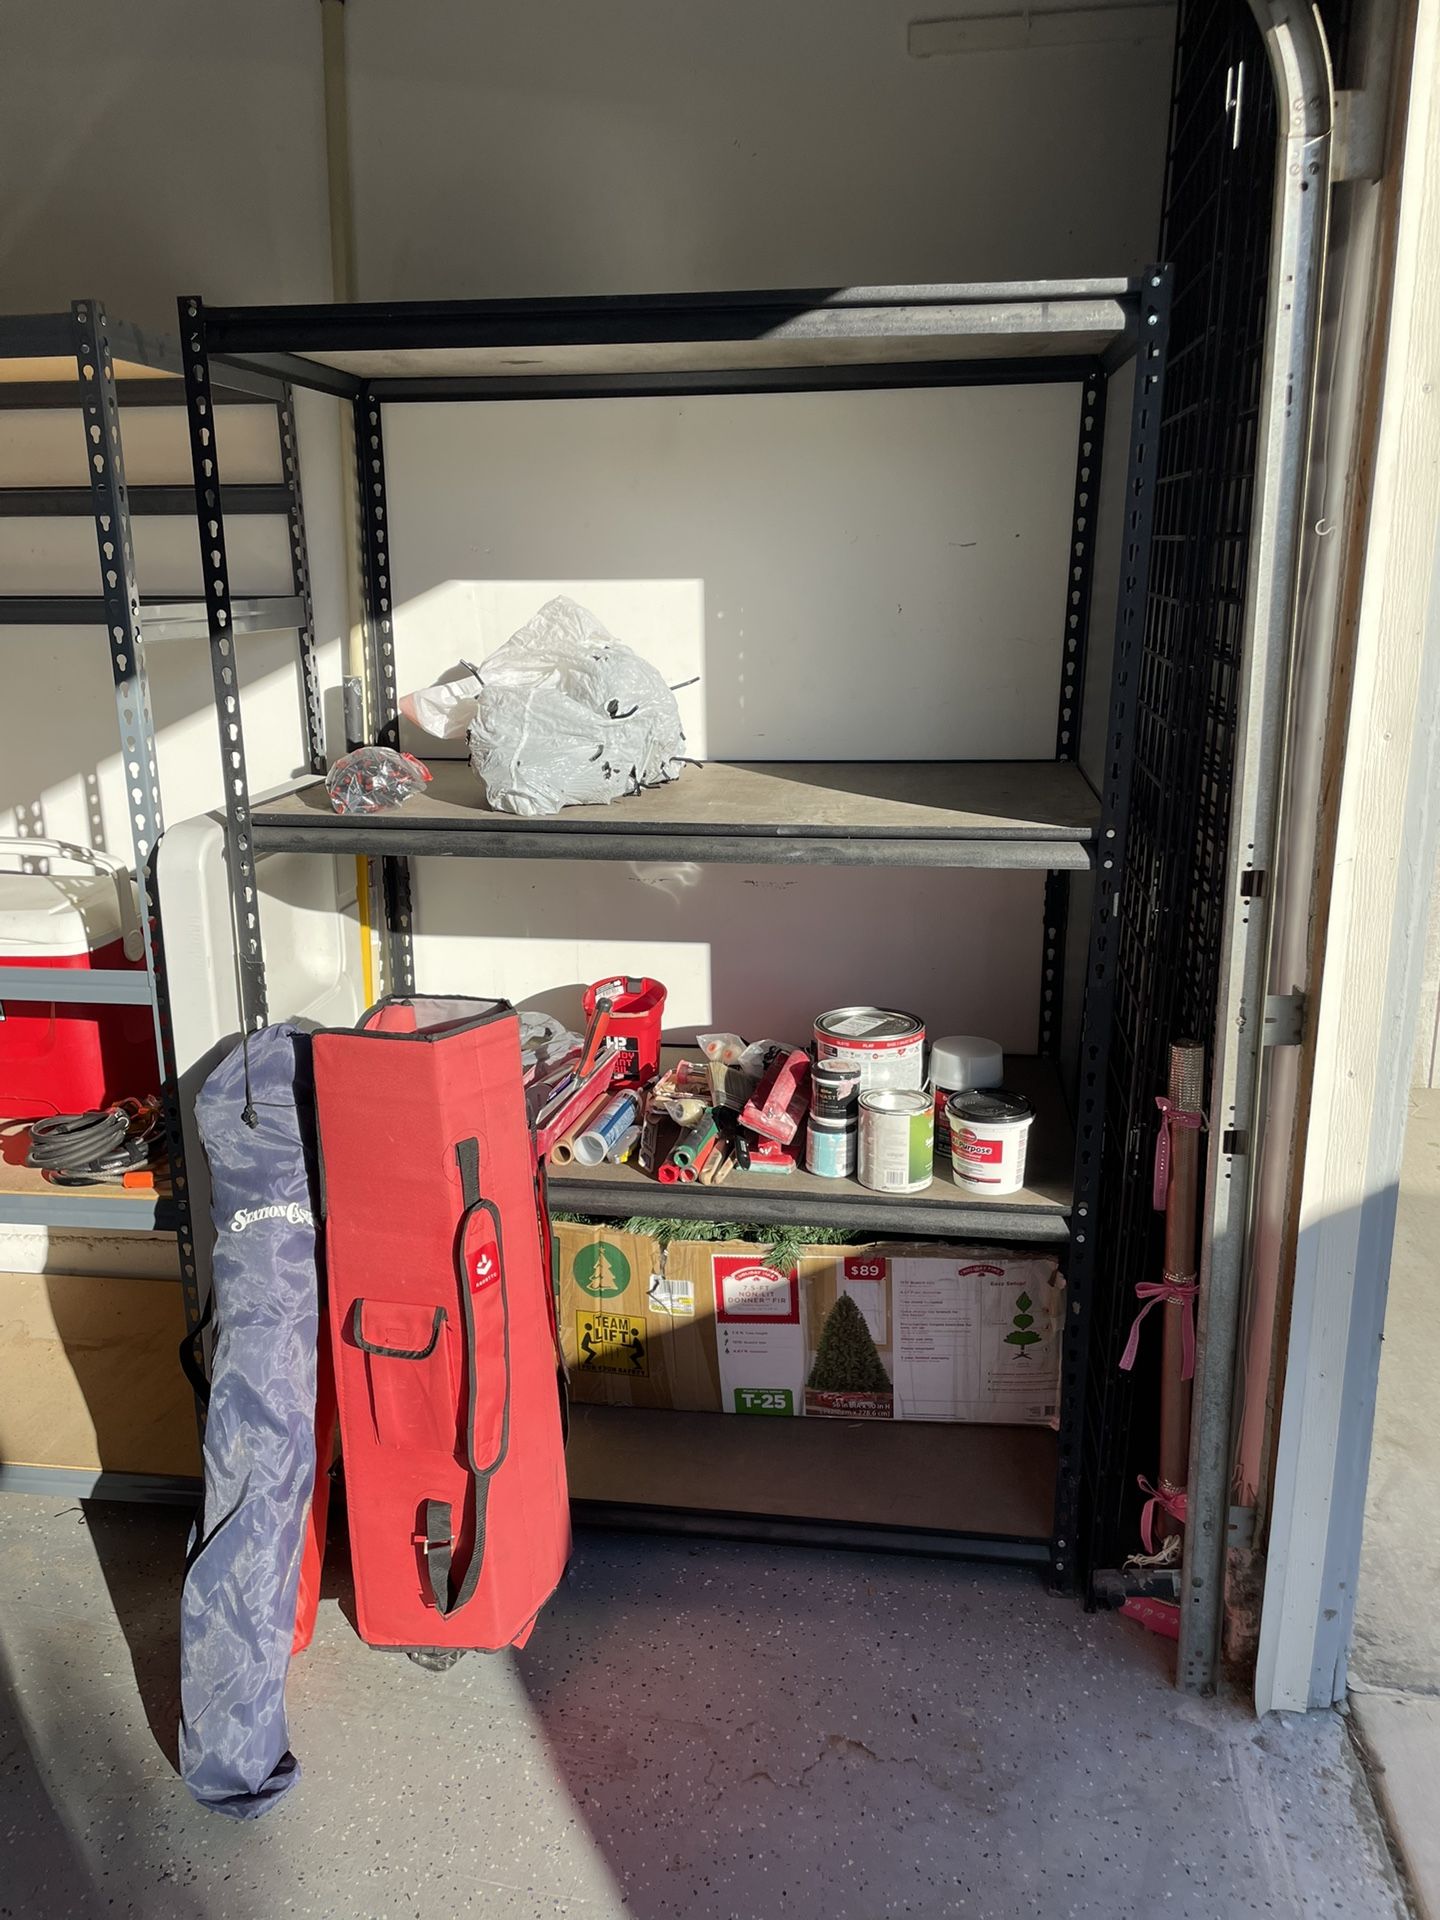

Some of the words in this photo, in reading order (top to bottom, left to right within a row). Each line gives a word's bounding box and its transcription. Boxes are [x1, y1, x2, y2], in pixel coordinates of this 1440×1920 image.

[959, 1141, 992, 1155] Purpose
[851, 1265, 879, 1276] $89
[595, 1316, 628, 1331] TEAM
[595, 1328, 628, 1343] LIFT
[741, 1393, 786, 1409] T-25
